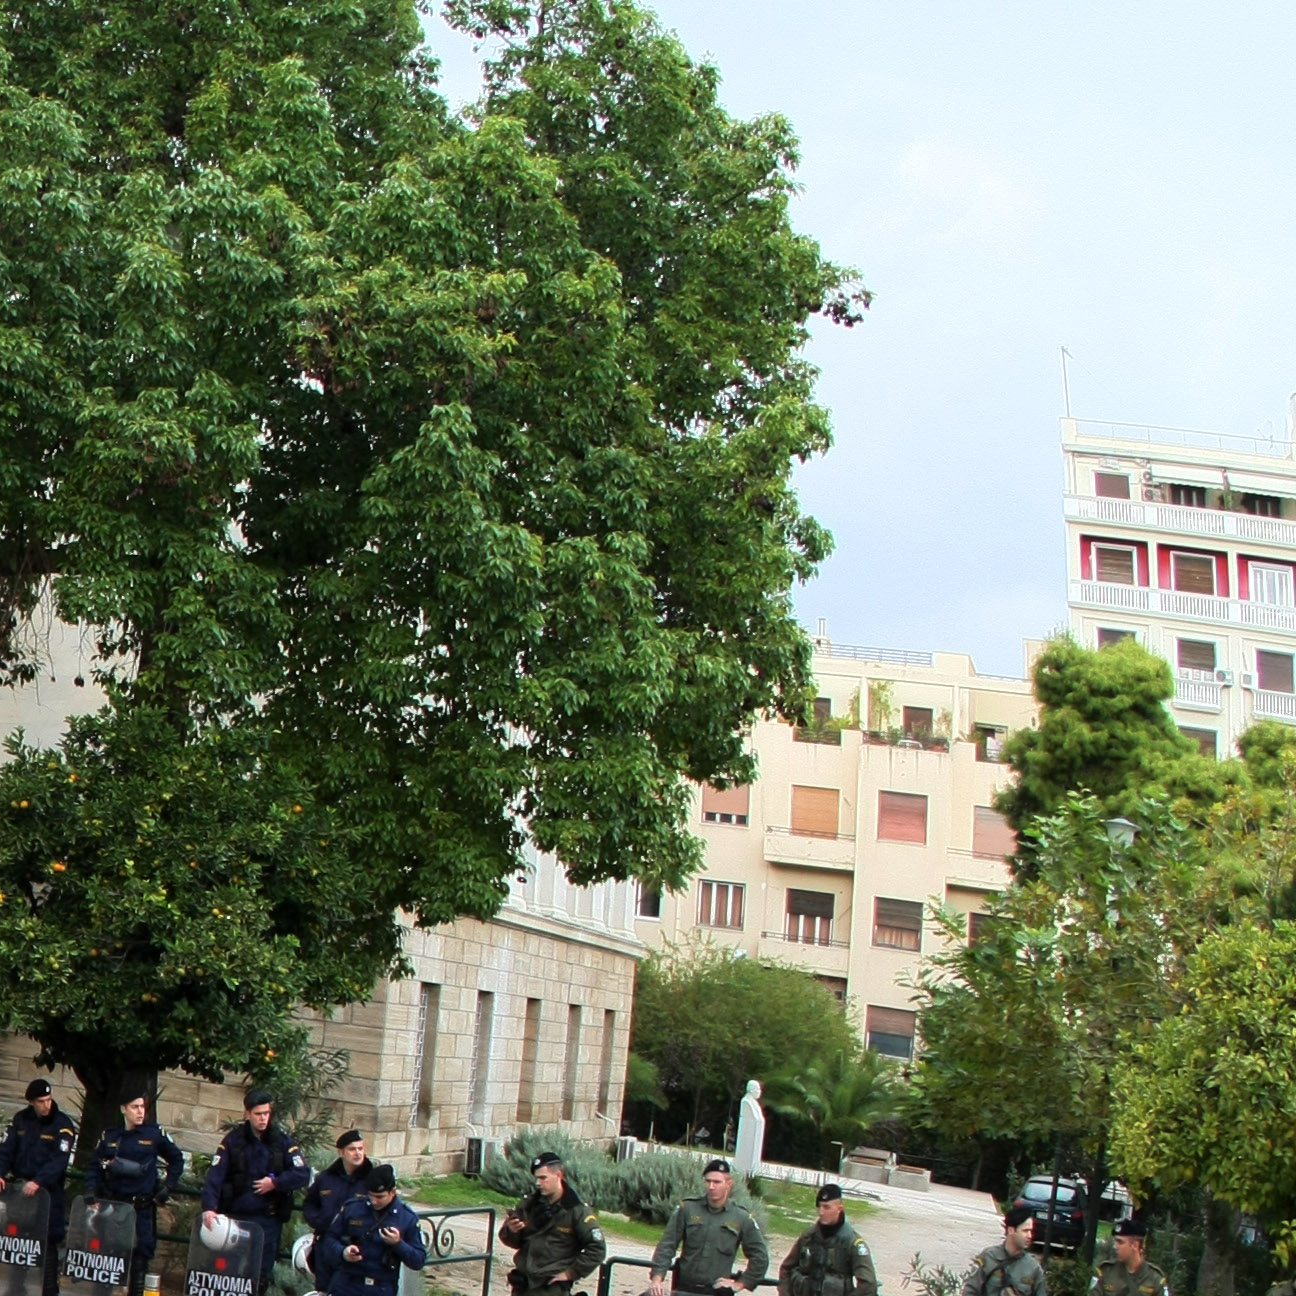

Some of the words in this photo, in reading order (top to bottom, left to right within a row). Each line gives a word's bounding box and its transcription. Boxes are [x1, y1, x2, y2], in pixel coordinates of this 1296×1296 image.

[66, 1249, 125, 1273] ΑΣΤΥΝΟΜΙΑ
[66, 1264, 120, 1285] POLICE
[188, 1270, 253, 1294] ΑΣΤΥΝΟΜΙΑ
